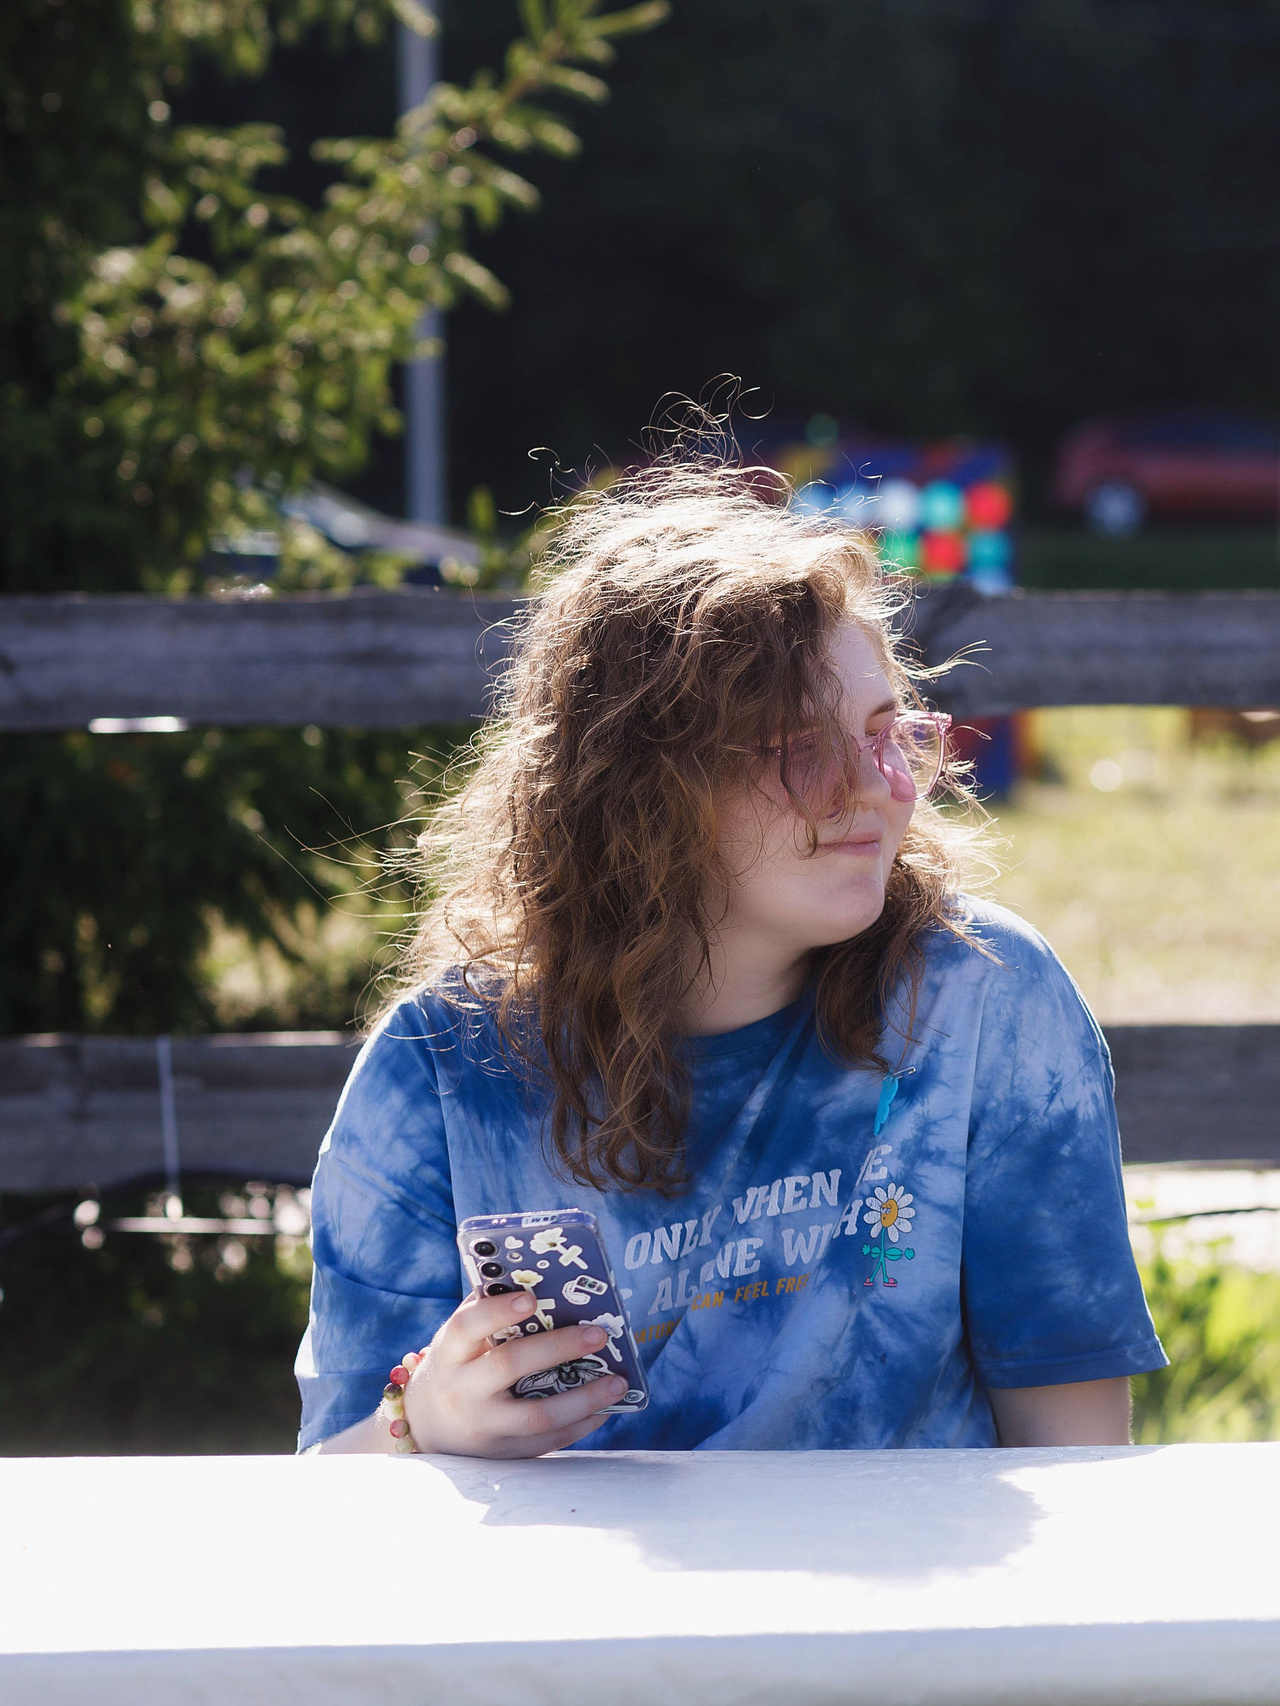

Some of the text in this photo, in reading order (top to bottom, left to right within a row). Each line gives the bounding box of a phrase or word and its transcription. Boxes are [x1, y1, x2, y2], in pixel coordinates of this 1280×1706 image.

[624, 1144, 893, 1270] ONLY WHEN E
[781, 1199, 864, 1267] WIH
[634, 1318, 681, 1345] ATUR
[691, 1290, 725, 1311] CAN
[734, 1280, 769, 1304] FEEL
